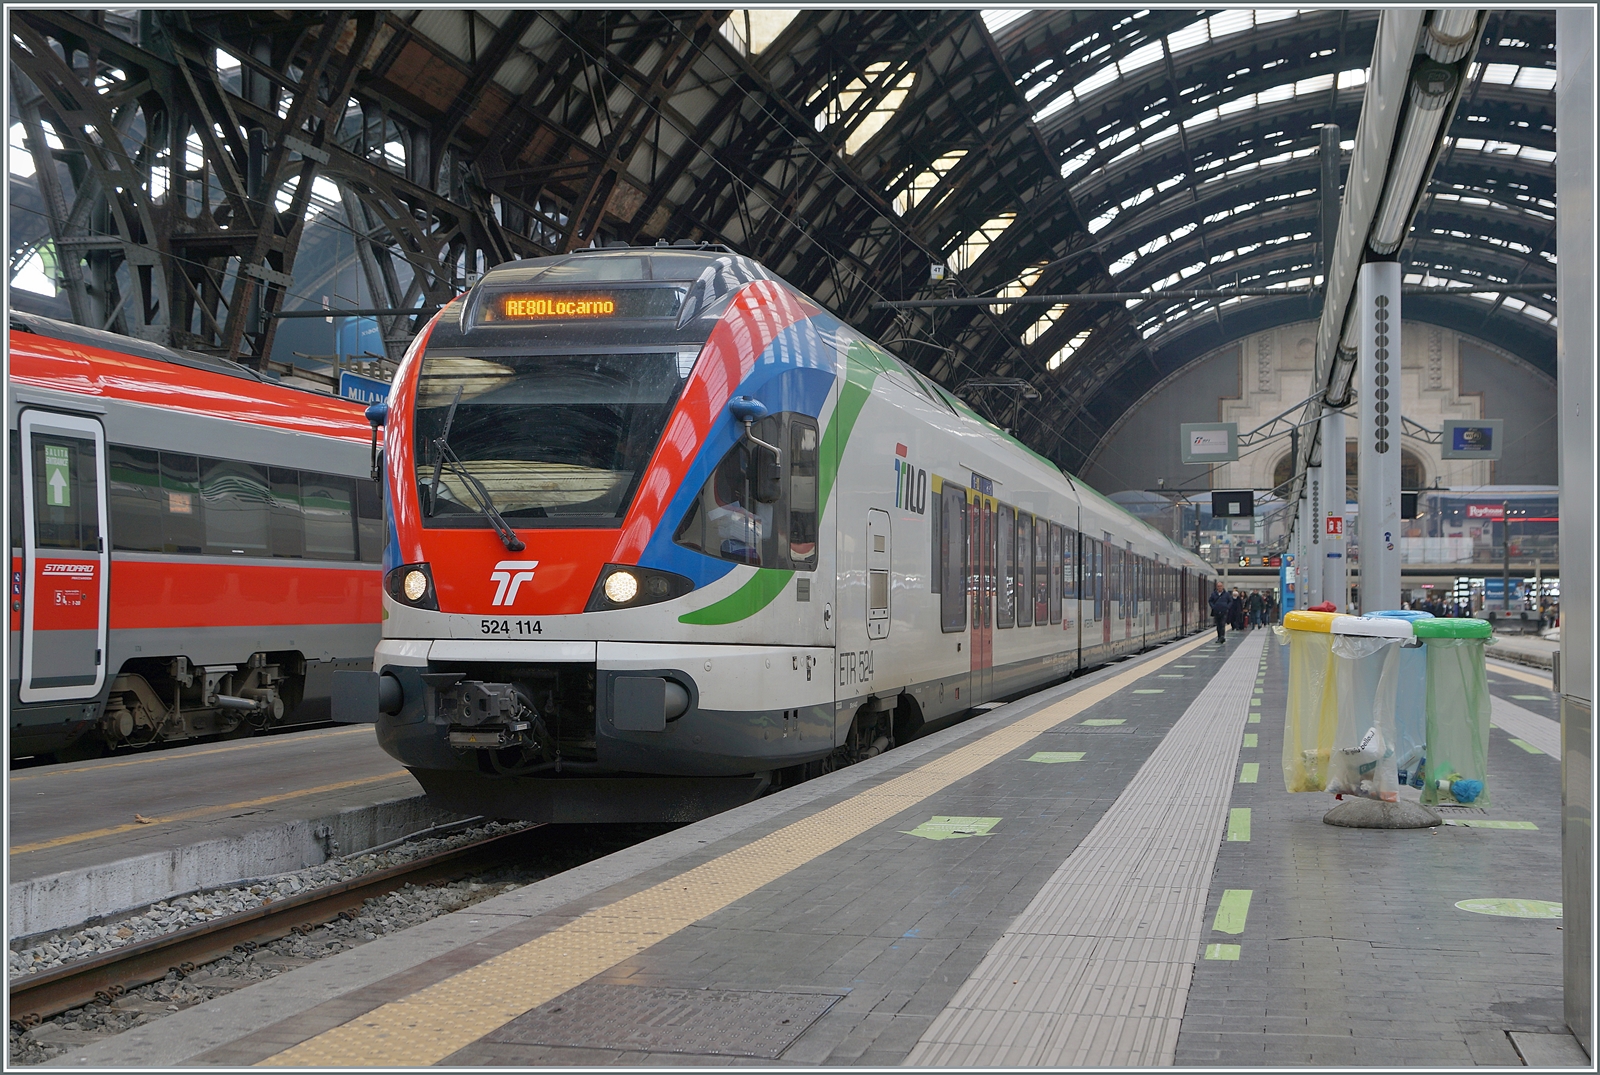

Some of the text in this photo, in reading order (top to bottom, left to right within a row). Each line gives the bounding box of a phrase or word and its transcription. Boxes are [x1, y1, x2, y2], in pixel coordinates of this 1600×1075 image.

[548, 299, 613, 315] Locarno
[45, 448, 69, 458] SALITA
[44, 563, 95, 573] STANDARD
[55, 592, 62, 603] 5
[481, 619, 543, 635] 524 114
[840, 650, 874, 686] ETR 524
